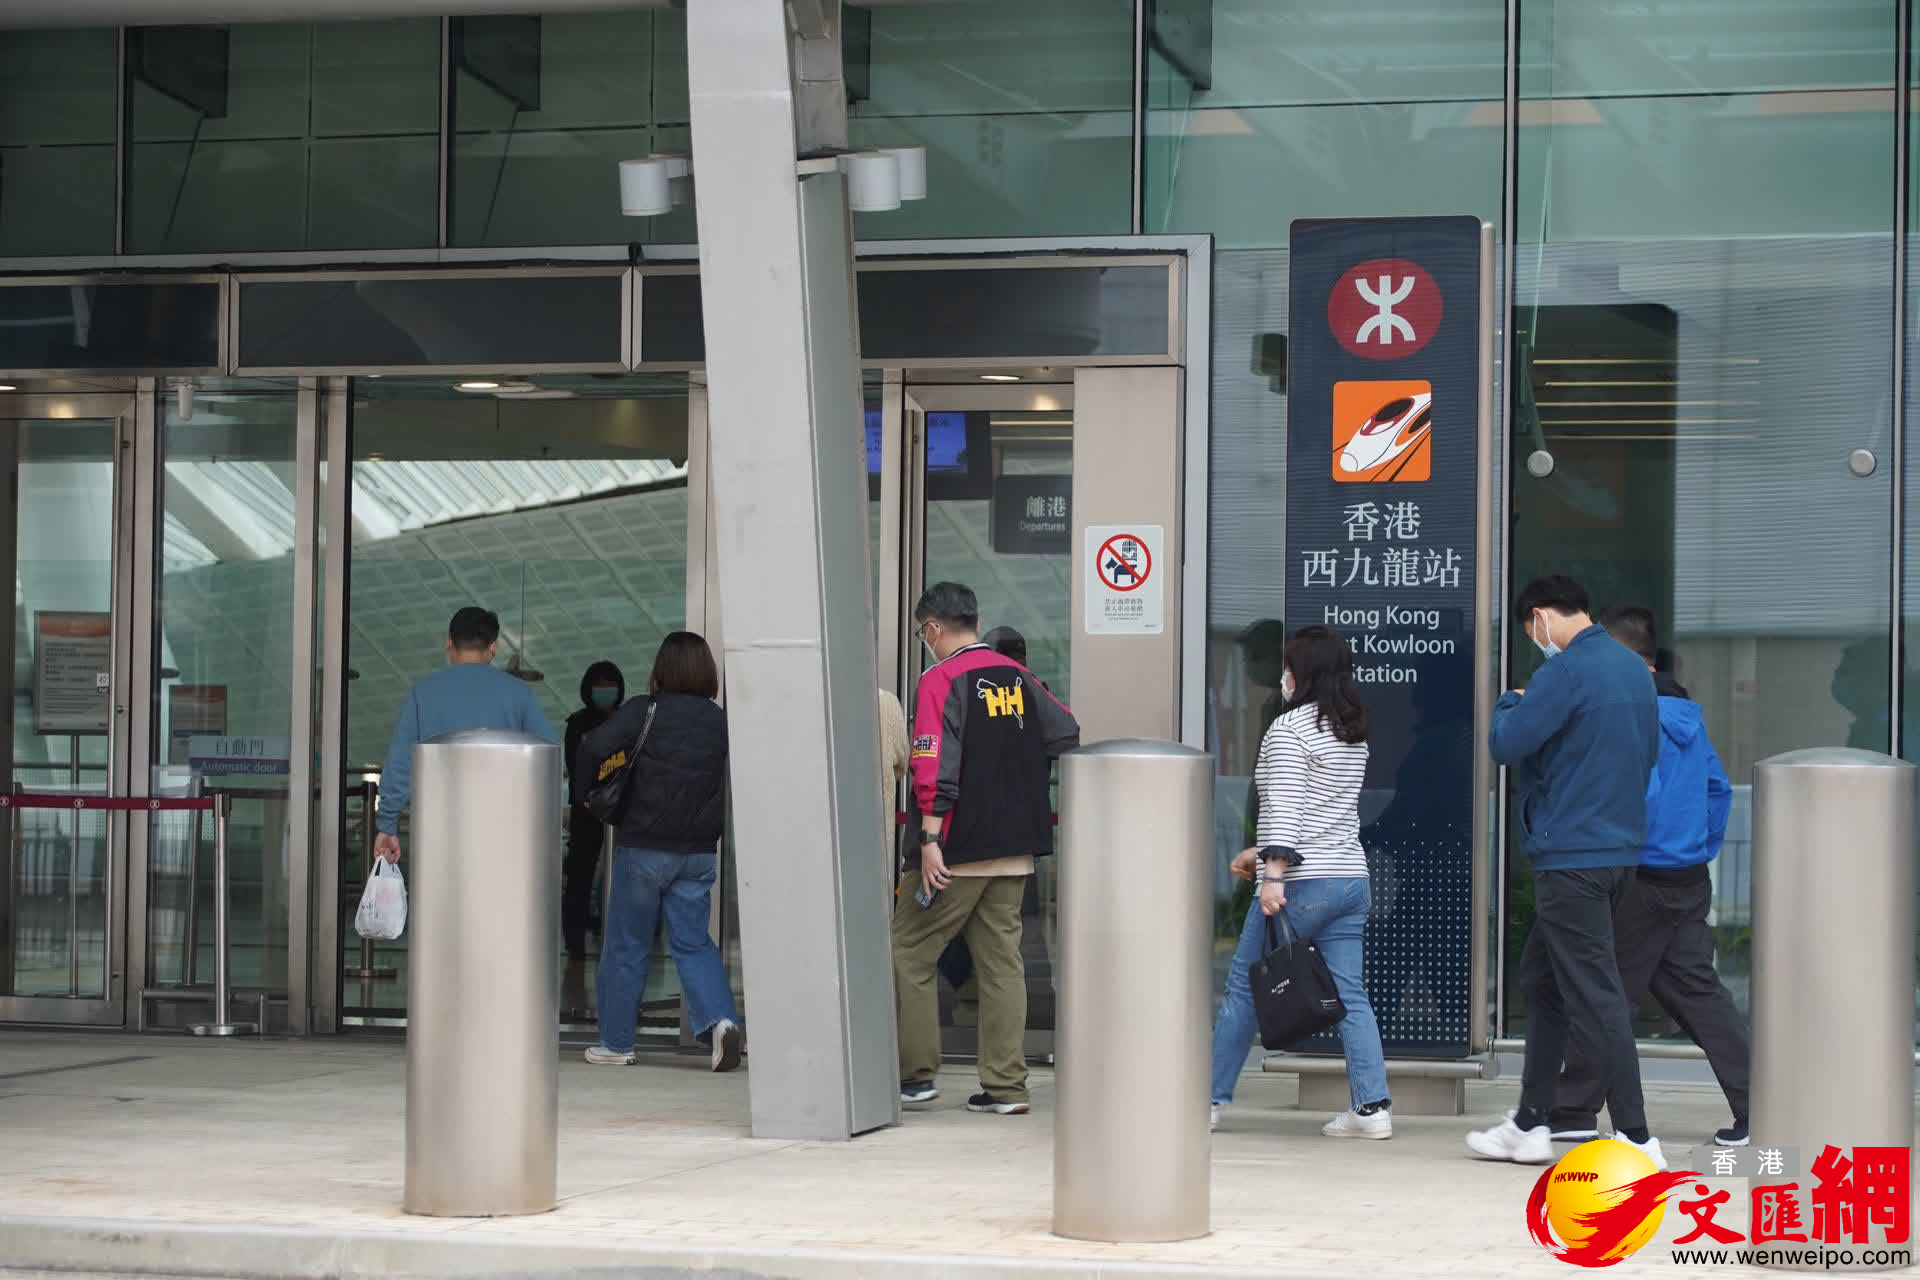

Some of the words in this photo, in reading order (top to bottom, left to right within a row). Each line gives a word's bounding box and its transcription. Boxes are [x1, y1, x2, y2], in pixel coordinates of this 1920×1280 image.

[1026, 496, 1066, 517] 離港
[1020, 520, 1066, 532] Departures
[1342, 501, 1421, 542] 香港
[1301, 547, 1462, 588] 西九龍站
[1323, 605, 1380, 629] Hong
[1386, 605, 1441, 629] Kong
[1364, 634, 1455, 654] Kowloon
[985, 686, 1025, 718] HH
[215, 736, 264, 756] 自動門
[200, 760, 250, 772] Automatic
[254, 760, 278, 773] door
